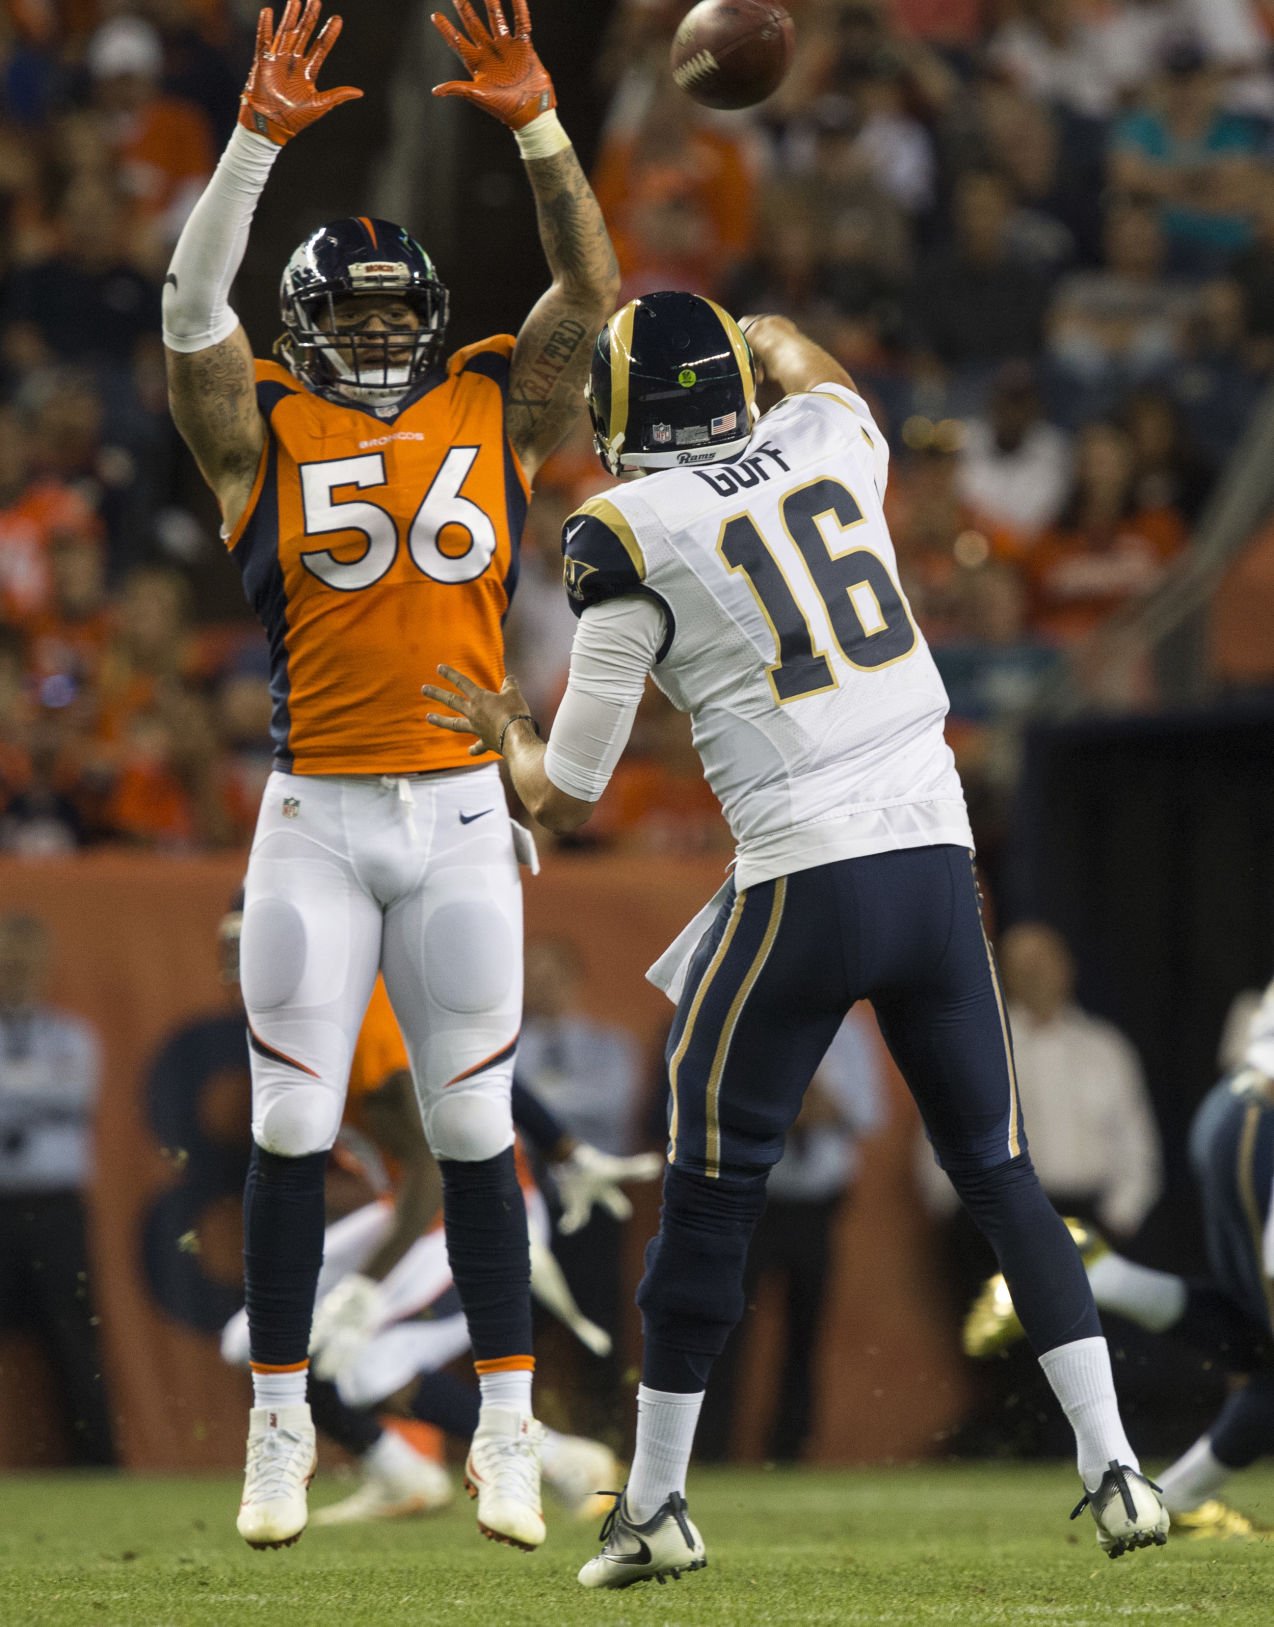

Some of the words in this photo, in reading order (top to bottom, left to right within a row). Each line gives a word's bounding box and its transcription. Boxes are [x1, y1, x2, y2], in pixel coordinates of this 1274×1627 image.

[358, 431, 425, 449] BRONCOS
[677, 451, 717, 464] Rams
[298, 444, 497, 592] 56
[715, 474, 919, 707] 16
